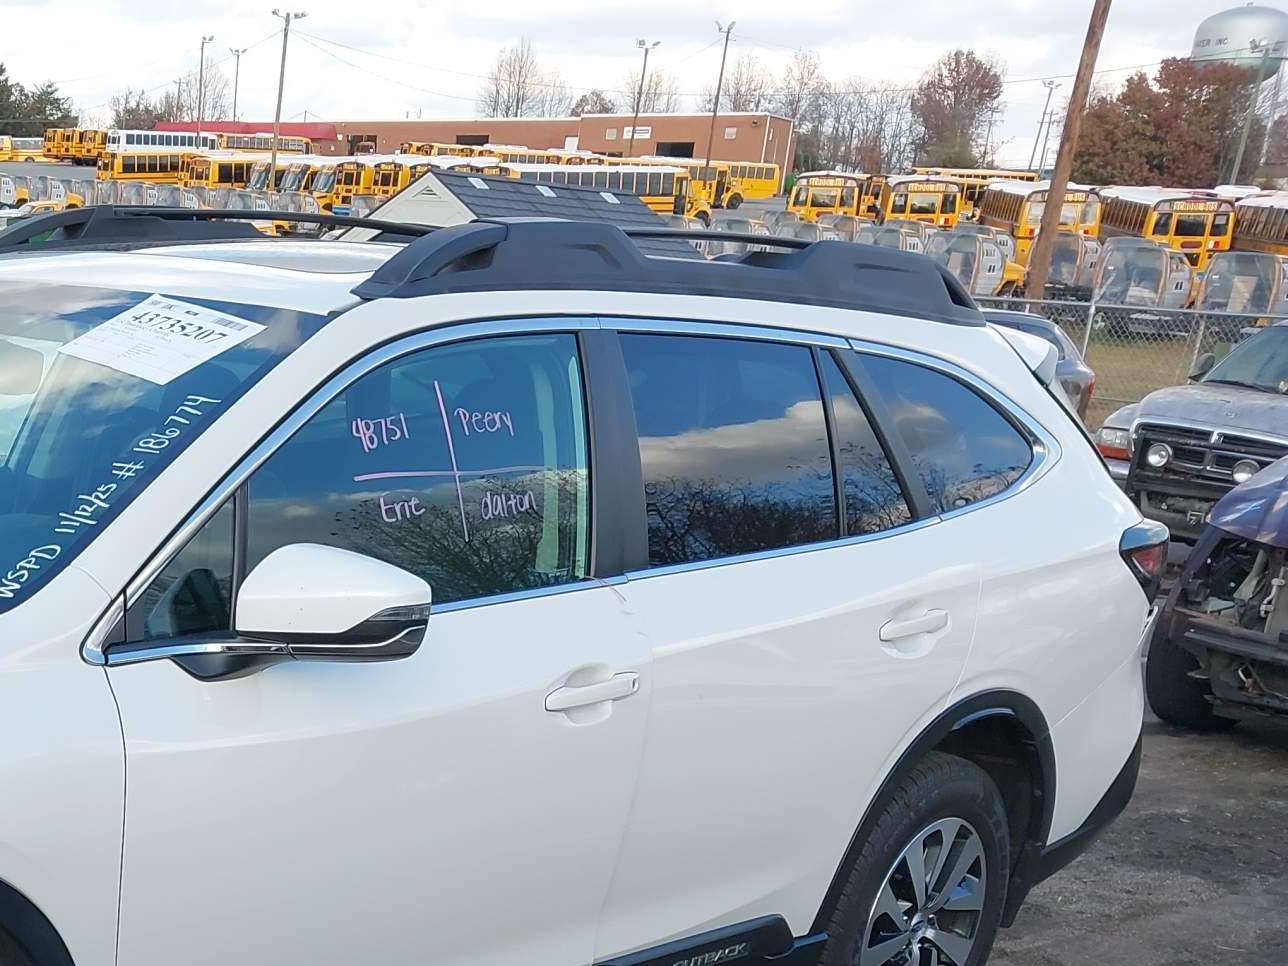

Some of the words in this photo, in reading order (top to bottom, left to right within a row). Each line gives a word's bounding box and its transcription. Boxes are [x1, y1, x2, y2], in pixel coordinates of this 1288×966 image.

[131, 311, 229, 344] 43735207
[133, 394, 222, 454] 186774
[351, 412, 409, 452] 48751
[379, 492, 426, 523] Erie
